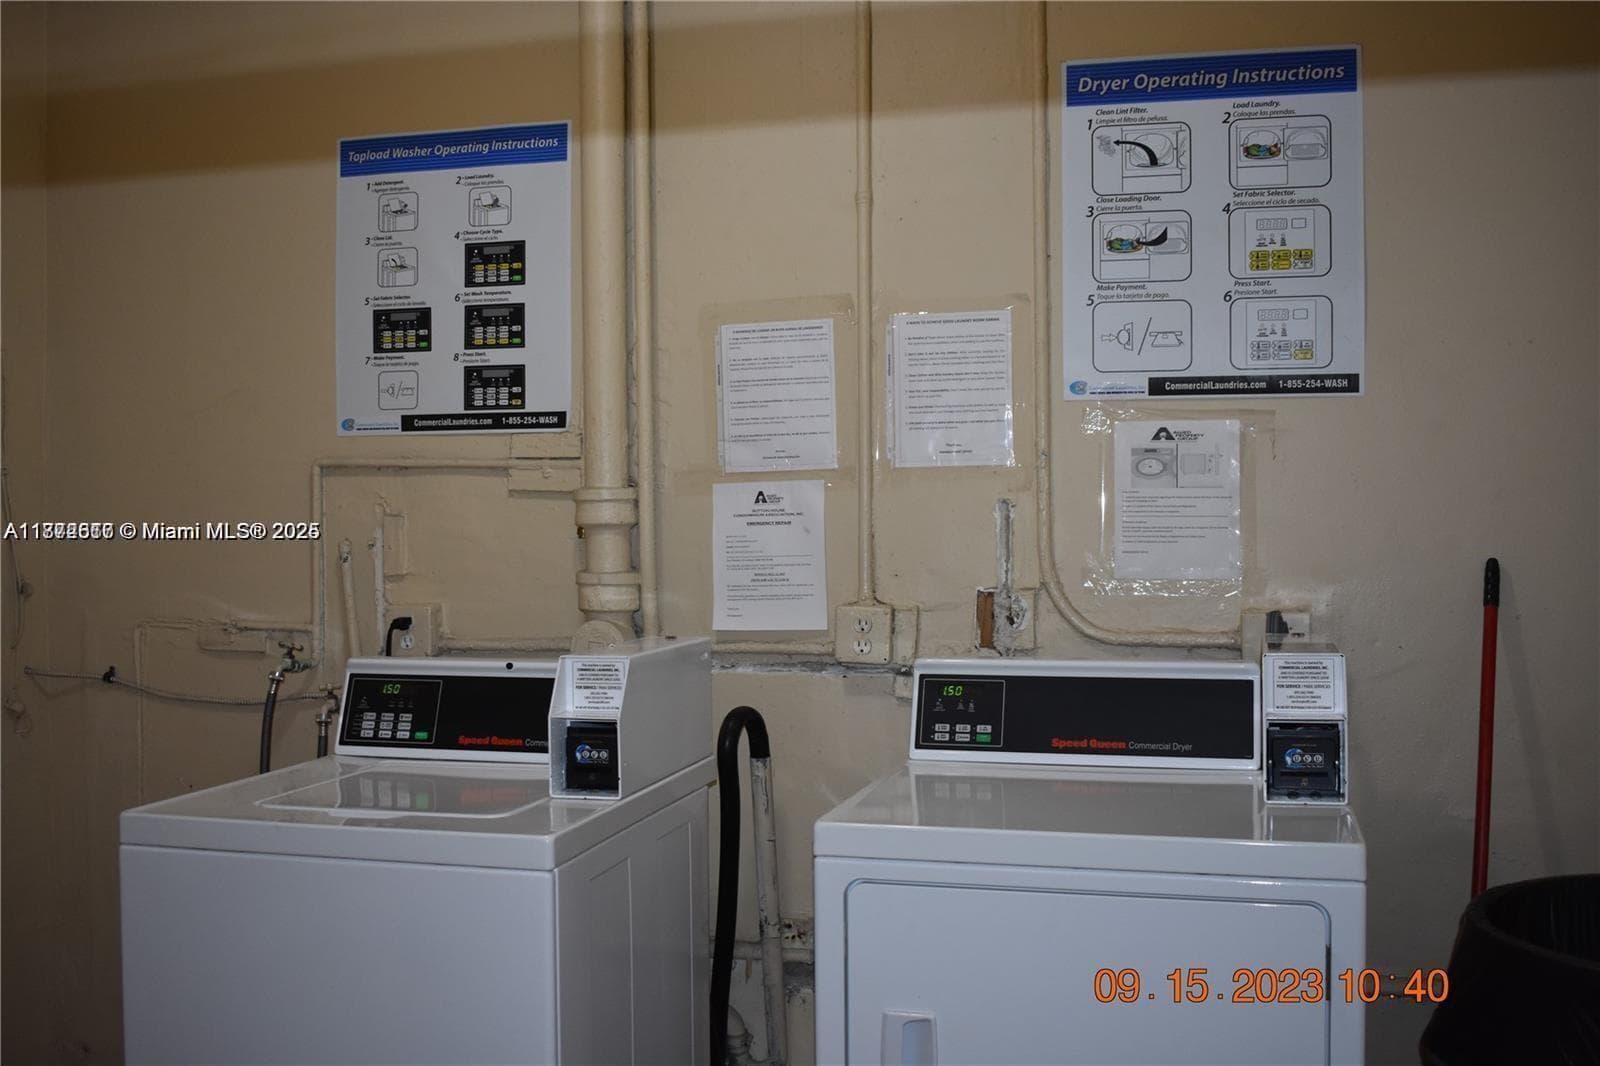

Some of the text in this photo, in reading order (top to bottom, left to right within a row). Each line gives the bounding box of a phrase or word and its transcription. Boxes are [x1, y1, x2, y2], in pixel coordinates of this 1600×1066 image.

[1078, 65, 1345, 95] Dryer Operating Instructions
[1232, 100, 1281, 109] Load Laundry.
[1096, 106, 1148, 116] Clean Lint Filter.
[1222, 112, 1231, 124] 2
[1087, 119, 1093, 131] 1
[348, 137, 559, 164] Topload Washer Operating Instructions
[456, 176, 461, 185] 2
[366, 182, 371, 191] 1
[1244, 190, 1265, 198] Fabric
[1267, 189, 1296, 197] Selector.
[1096, 194, 1162, 204] Close Loading Door.
[1086, 206, 1094, 218] 3
[1222, 202, 1231, 214] 4
[454, 231, 460, 240] 4
[365, 236, 370, 246] 3
[1116, 284, 1147, 292] Payment.
[1253, 279, 1272, 287] Start.
[454, 293, 460, 302] 6
[1086, 294, 1095, 306] 5
[1223, 290, 1232, 302] 6
[364, 297, 370, 306] 5
[365, 356, 370, 365] 7
[453, 352, 459, 362] 8
[1165, 378, 1348, 391] CommercialLaundries.com 1-855-254-WASH
[414, 415, 558, 427] CommercialLaundries.com 1-855-254-WASH
[457, 735, 490, 746] Speed
[491, 736, 523, 746] Queen
[1051, 738, 1193, 751] Speed Queen Commercial Dryer
